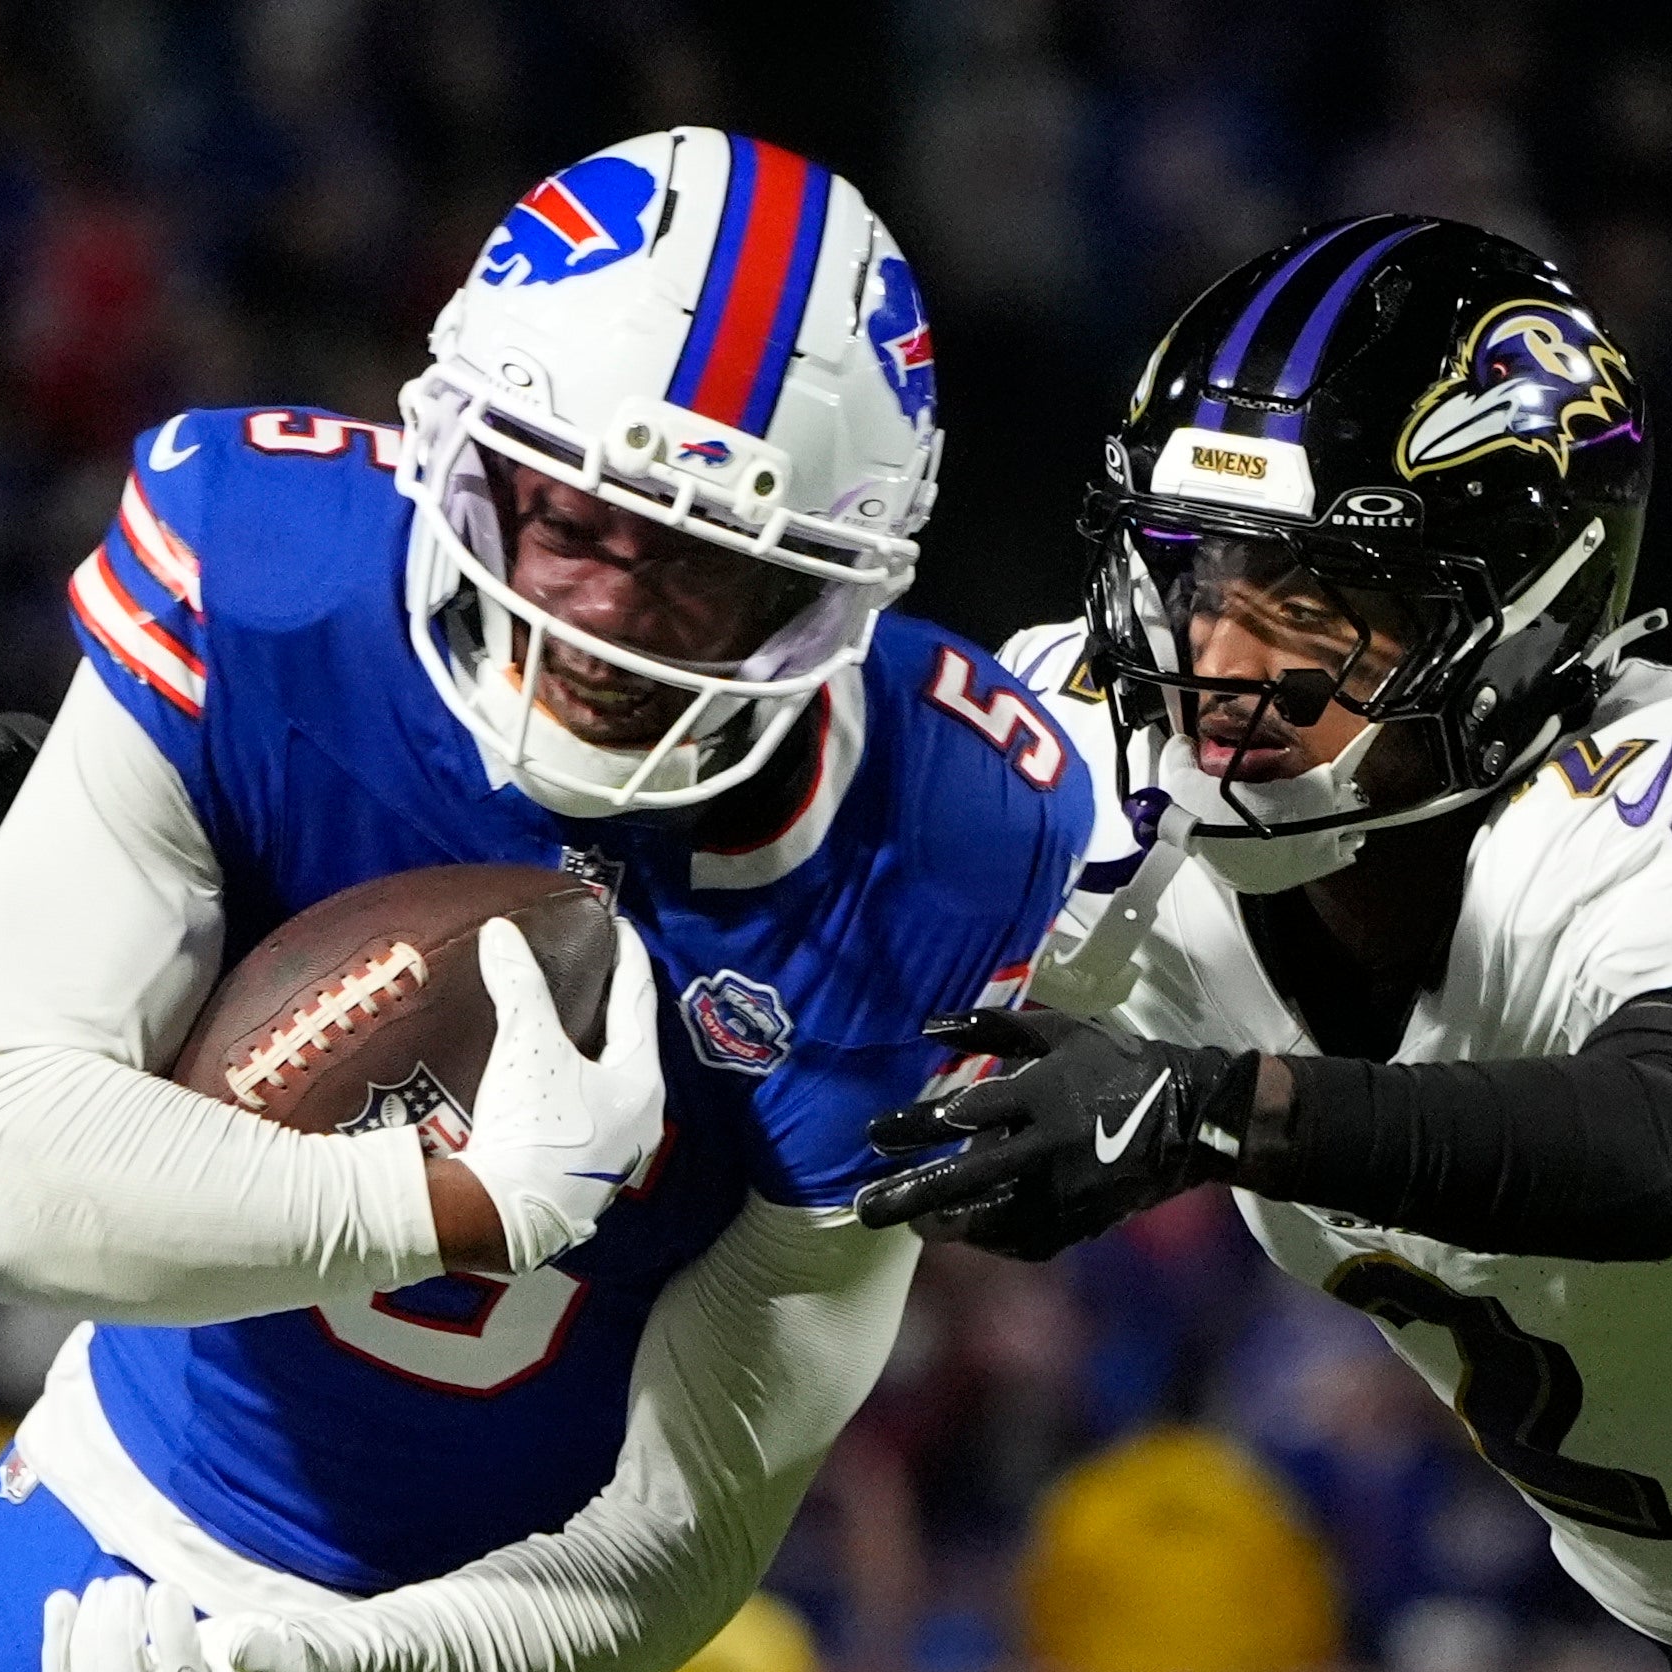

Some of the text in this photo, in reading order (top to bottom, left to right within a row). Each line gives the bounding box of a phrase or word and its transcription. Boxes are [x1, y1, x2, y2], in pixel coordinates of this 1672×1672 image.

[245, 410, 404, 472] 5
[1192, 446, 1268, 480] RAVENS
[1331, 515, 1417, 528] OAKLEY
[927, 644, 1067, 788] 5
